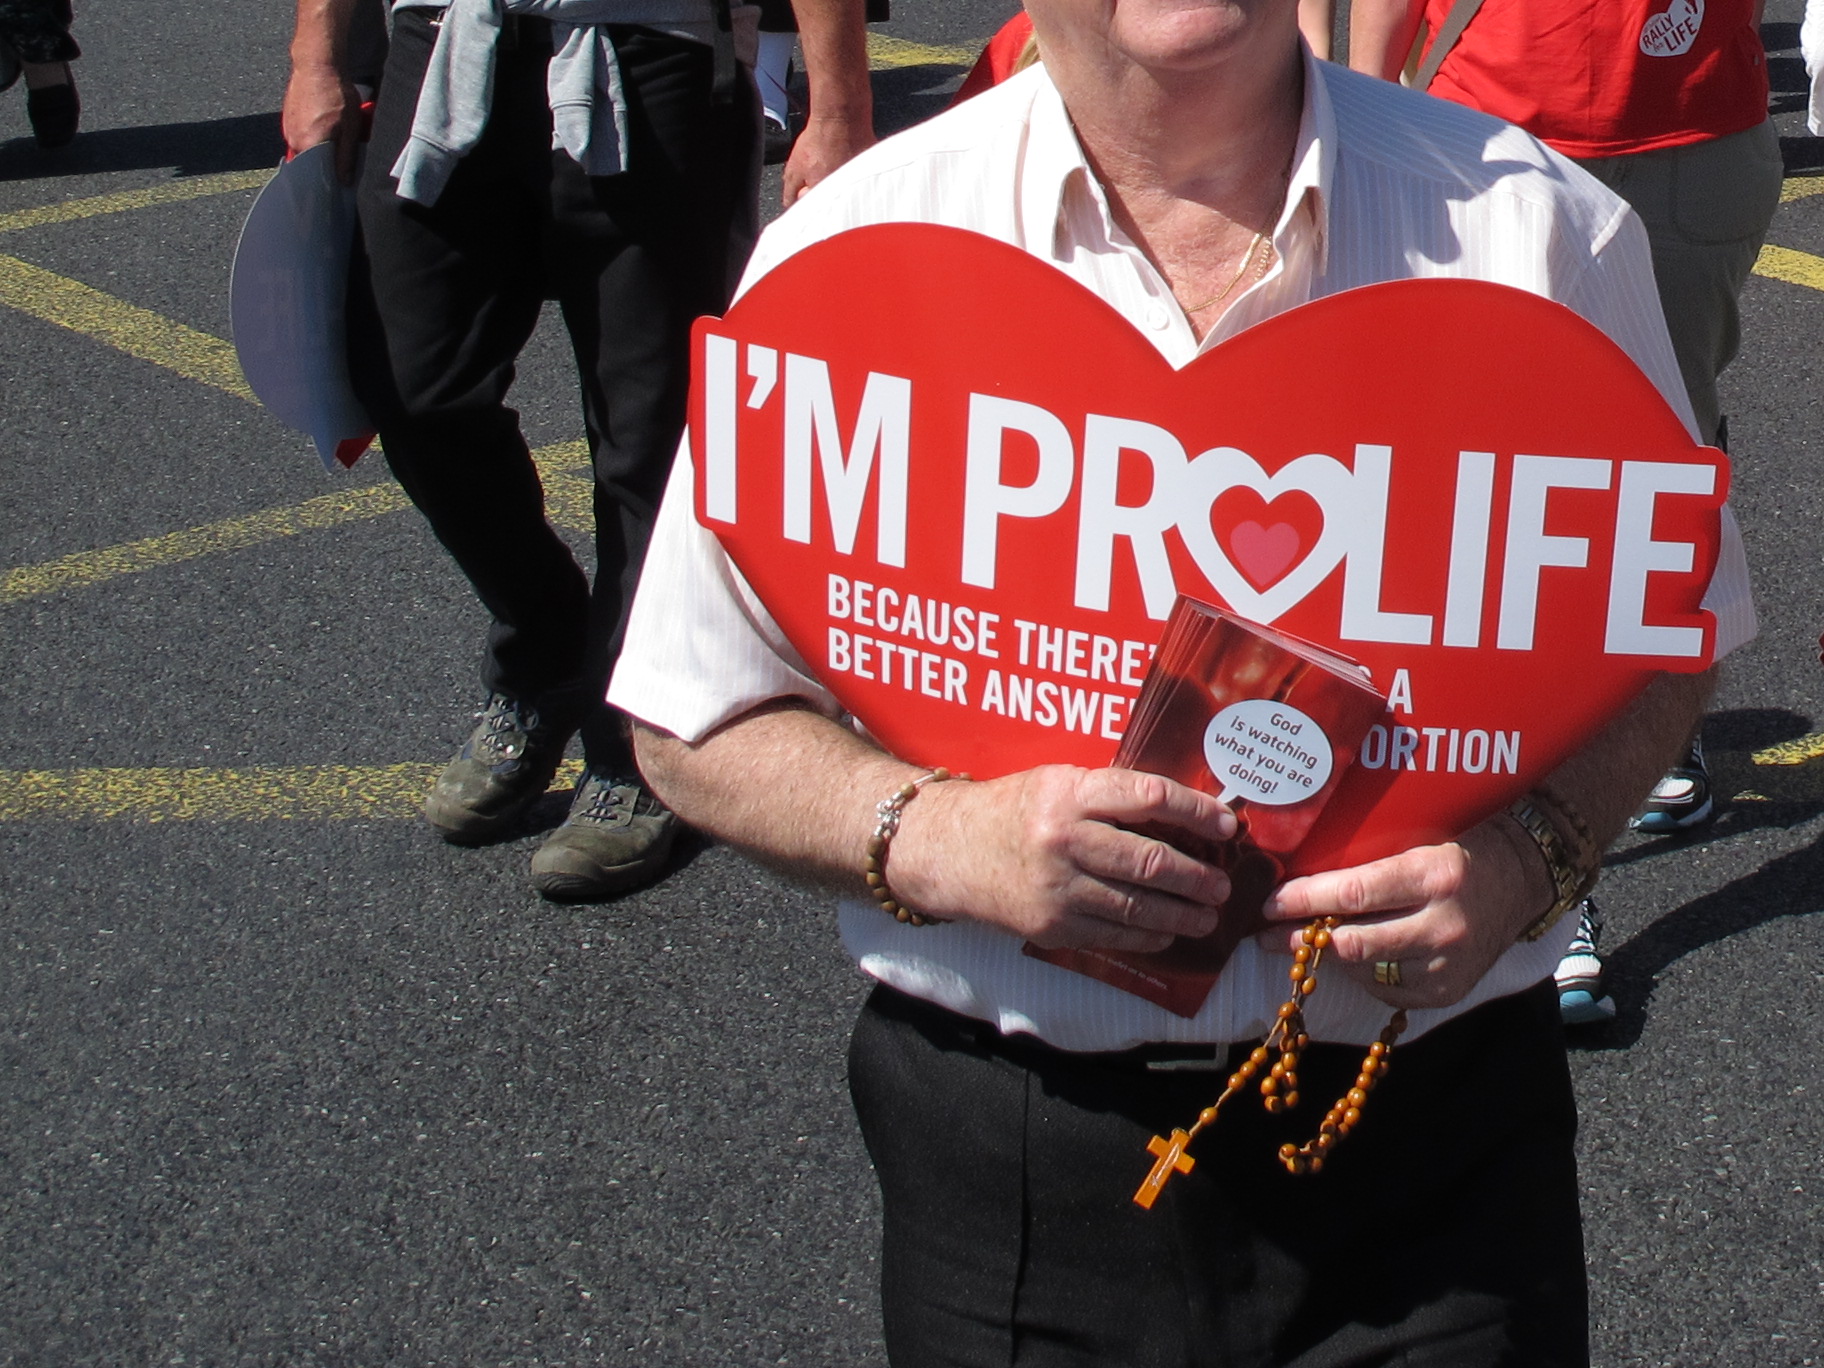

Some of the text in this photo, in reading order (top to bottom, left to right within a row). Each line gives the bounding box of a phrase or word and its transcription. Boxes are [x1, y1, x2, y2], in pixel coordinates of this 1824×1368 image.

[1642, 13, 1675, 49] RALLY
[1663, 16, 1698, 52] LIFE
[702, 332, 1718, 658] I'M PROLIFE
[827, 573, 1414, 714] BECAUSE THERE' A
[827, 625, 1522, 775] BETTER ANSWE ORTION
[1269, 712, 1303, 736] God
[1214, 732, 1314, 788] what you are
[1230, 715, 1318, 770] is watching
[1228, 762, 1279, 794] doing!
